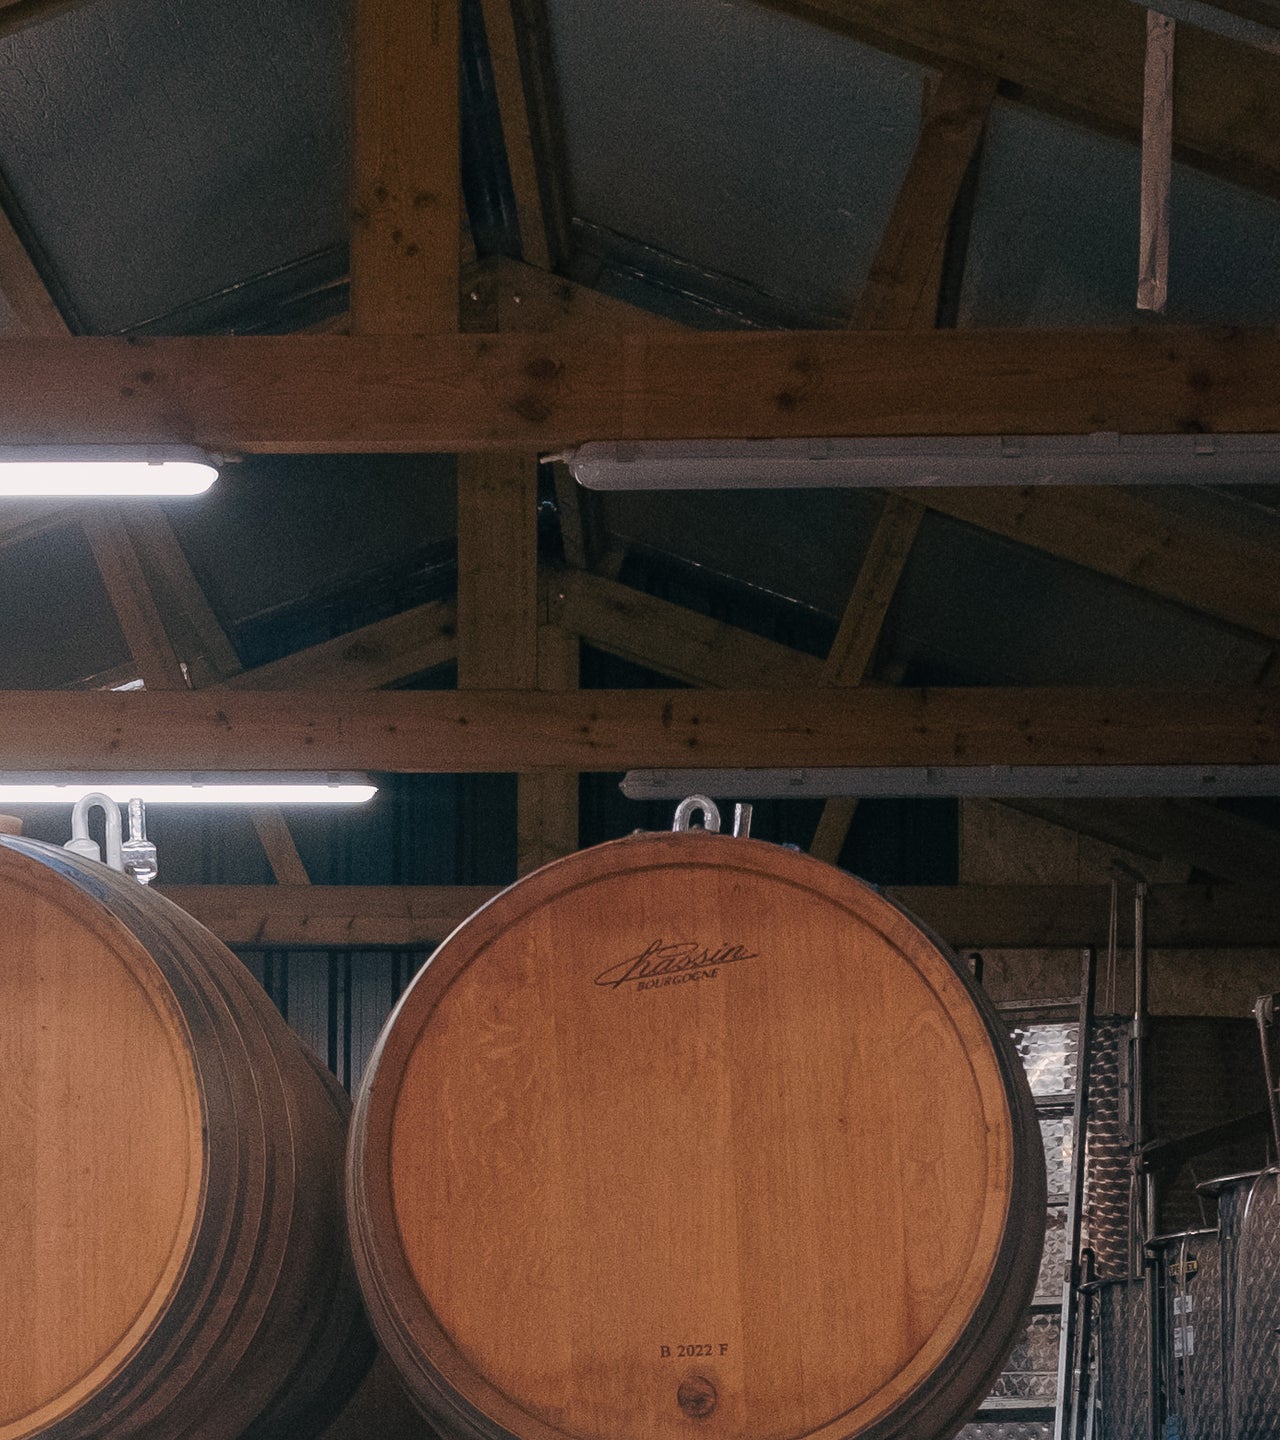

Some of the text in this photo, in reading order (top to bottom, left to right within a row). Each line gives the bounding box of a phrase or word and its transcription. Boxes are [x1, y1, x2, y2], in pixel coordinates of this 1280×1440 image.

[637, 968, 719, 991] BOURGOGNE
[660, 1343, 728, 1358] B 2022 F
